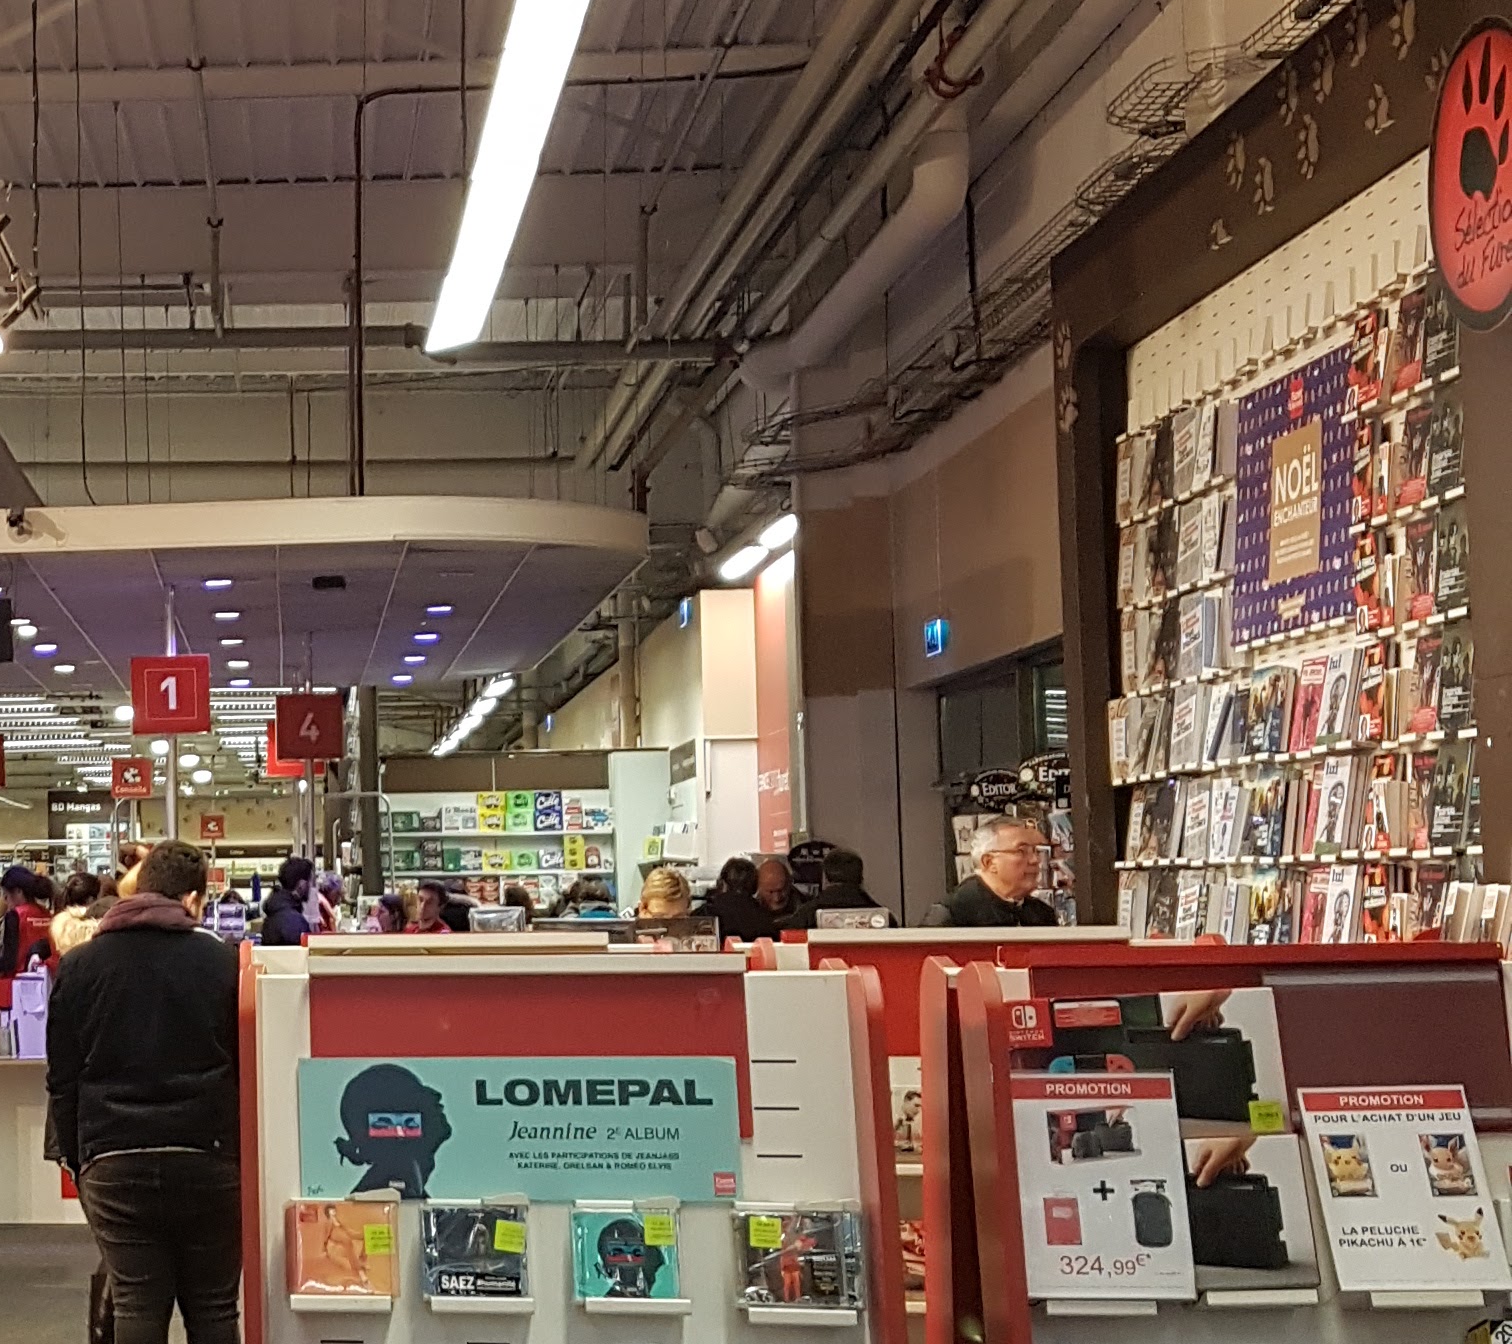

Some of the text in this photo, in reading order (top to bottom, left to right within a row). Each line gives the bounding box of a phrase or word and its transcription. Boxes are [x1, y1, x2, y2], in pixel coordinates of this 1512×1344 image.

[1275, 445, 1319, 505] NOËL
[160, 676, 177, 710] 1
[298, 711, 320, 744] 4
[51, 802, 101, 813] BD Mangas
[475, 1078, 713, 1106] LOMEPAL
[1045, 1082, 1131, 1096] PROMOTION
[1339, 1094, 1424, 1106] PROMOTION
[1314, 1112, 1461, 1123] POUR L'ACHAT D'UN JEU
[507, 1121, 680, 1142] Jeannine ALBUM
[621, 1152, 632, 1160] DE
[1390, 1163, 1408, 1173] OU
[1342, 1226, 1419, 1235] LA PELUCHE
[1338, 1237, 1394, 1248] PIKACHU
[441, 1274, 475, 1290] SAEZ
